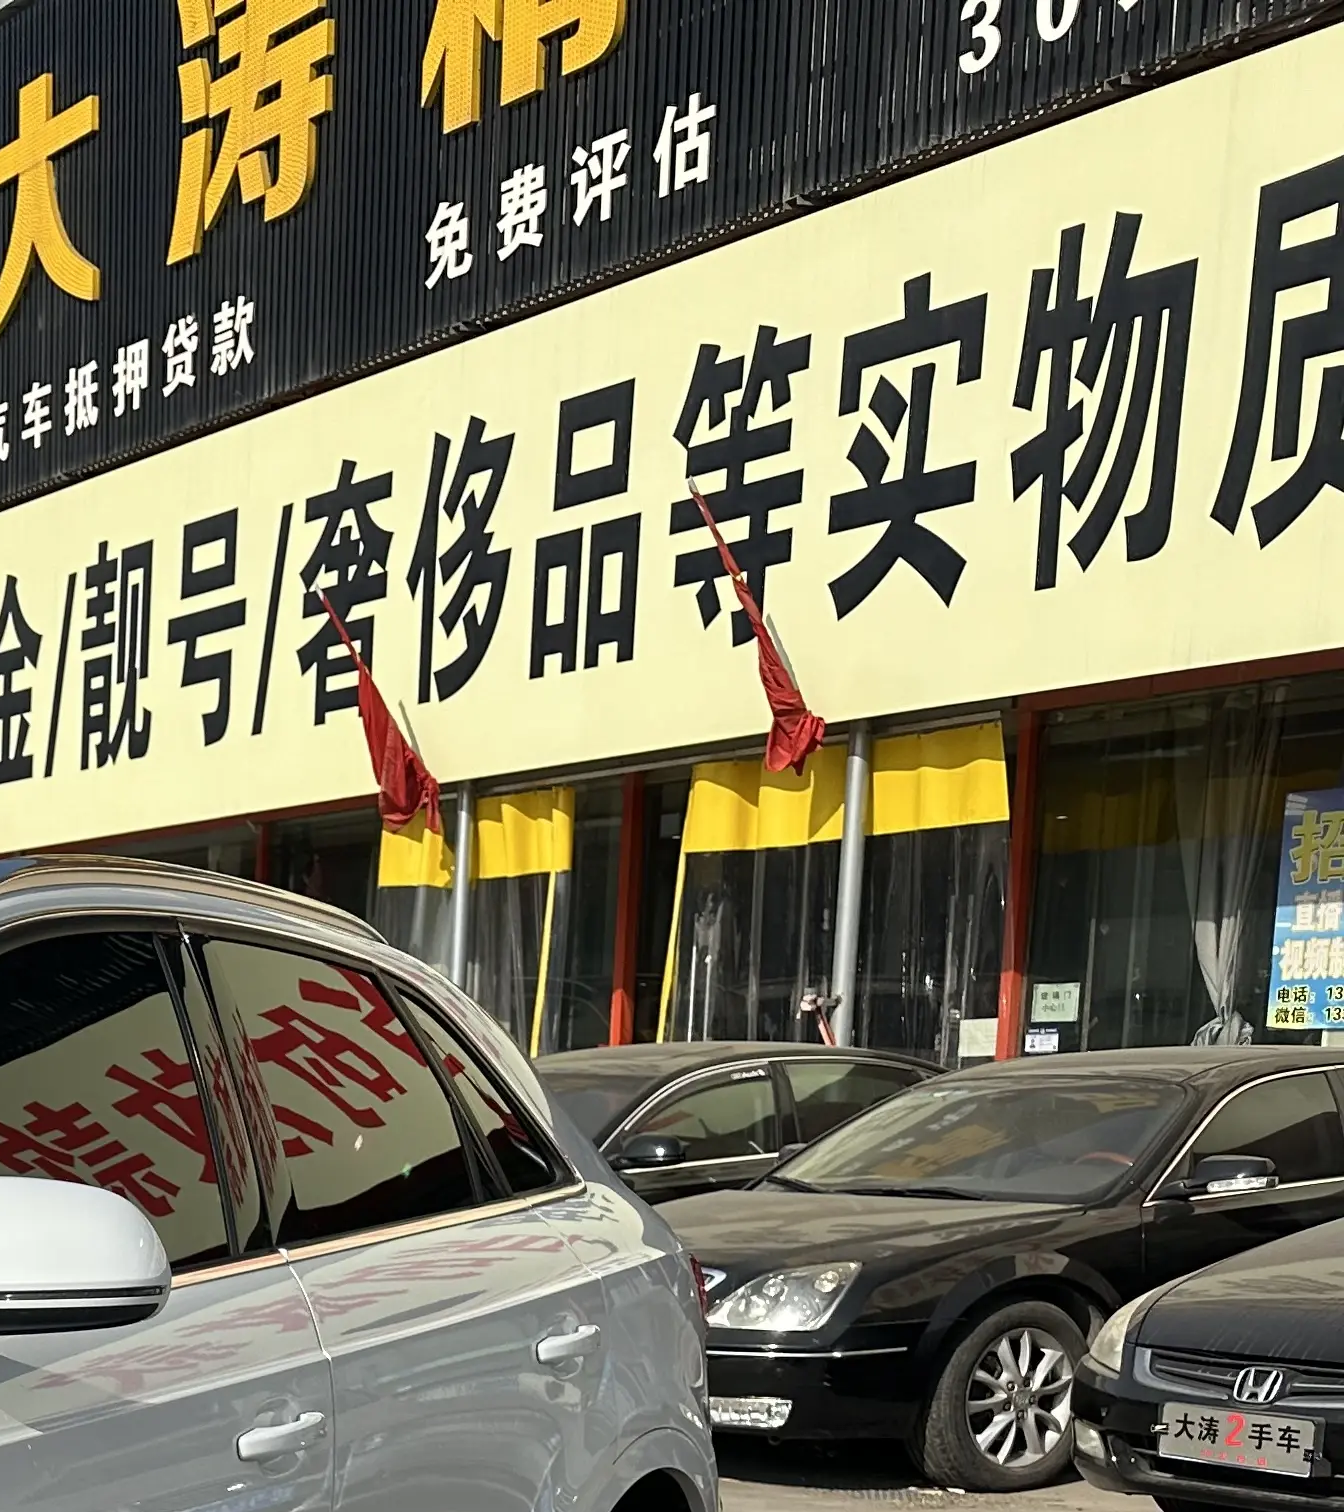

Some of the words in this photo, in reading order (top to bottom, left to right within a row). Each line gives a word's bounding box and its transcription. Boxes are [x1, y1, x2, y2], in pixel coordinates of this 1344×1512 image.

[423, 92, 716, 291] 免费评估
[1325, 1006, 1344, 1022] 13
[1173, 1411, 1301, 1454] 大涛2手车
